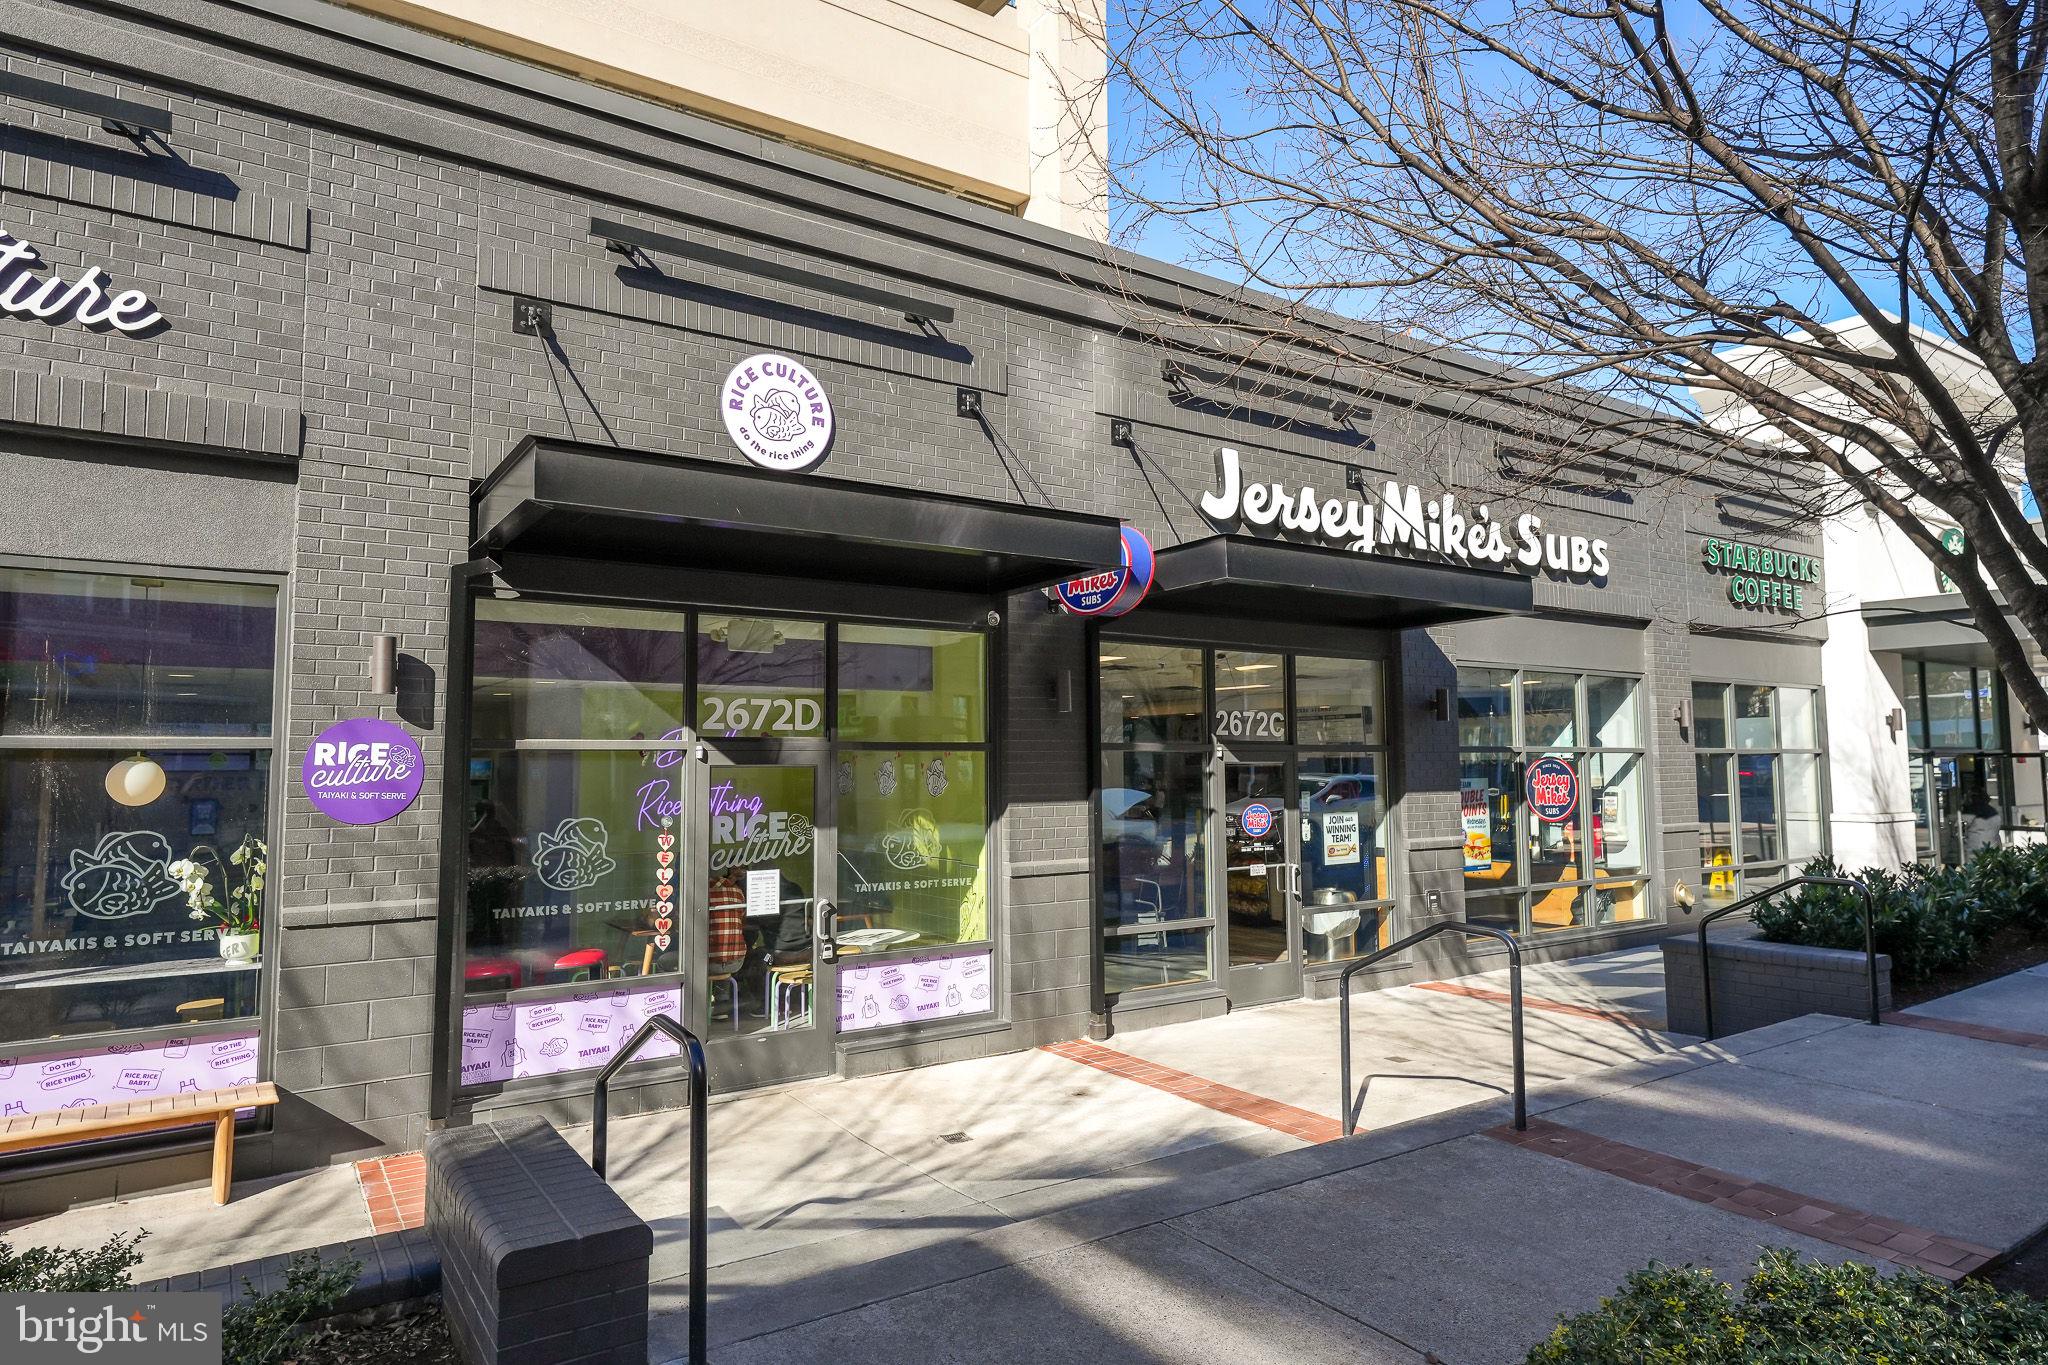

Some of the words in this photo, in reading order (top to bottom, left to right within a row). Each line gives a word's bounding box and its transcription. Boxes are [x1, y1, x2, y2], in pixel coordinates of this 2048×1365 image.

[728, 367, 759, 411] RICE
[762, 361, 825, 428] CULTURE
[739, 426, 750, 441] do
[750, 440, 767, 456] the
[768, 451, 789, 461] rice
[790, 440, 815, 459] thing
[1200, 447, 1376, 553] Jersey
[1381, 479, 1512, 562] Mike's
[1704, 537, 1822, 584] STARBUCKS
[1081, 594, 1102, 606] SUBS
[1730, 574, 1805, 612] COFFEE
[702, 697, 821, 731] 2672D
[1215, 709, 1285, 737] 2672C
[313, 741, 390, 767] RICE
[310, 754, 412, 788] culture
[1532, 768, 1571, 793] Jersey
[359, 792, 380, 800] SOFT
[381, 792, 407, 800] SERVE
[1329, 815, 1344, 825] JOIN
[1545, 807, 1560, 815] SUBS
[712, 811, 788, 845] RICE
[1325, 824, 1357, 834] WINNING
[1331, 833, 1352, 843] TEAM!
[710, 827, 811, 871] culture
[854, 881, 902, 893] TAIYAKIS
[904, 881, 911, 889] &
[914, 879, 941, 889] SOFT
[941, 877, 972, 887] SERVE
[493, 905, 558, 920] TAIYAKIS
[563, 904, 572, 914] &
[576, 901, 612, 914] SOFT
[614, 898, 656, 912] SERVE
[1, 936, 98, 957] TAIYAKIS
[103, 935, 117, 948] &
[124, 931, 176, 947] SOFT
[917, 1001, 940, 1012] TAIYAKI
[230, 1053, 251, 1062] THING
[578, 1045, 610, 1058] TAIYAKI
[49, 1063, 61, 1072] DO
[61, 1060, 77, 1069] THE
[45, 1078, 63, 1088] RICE
[64, 1072, 87, 1082] THING
